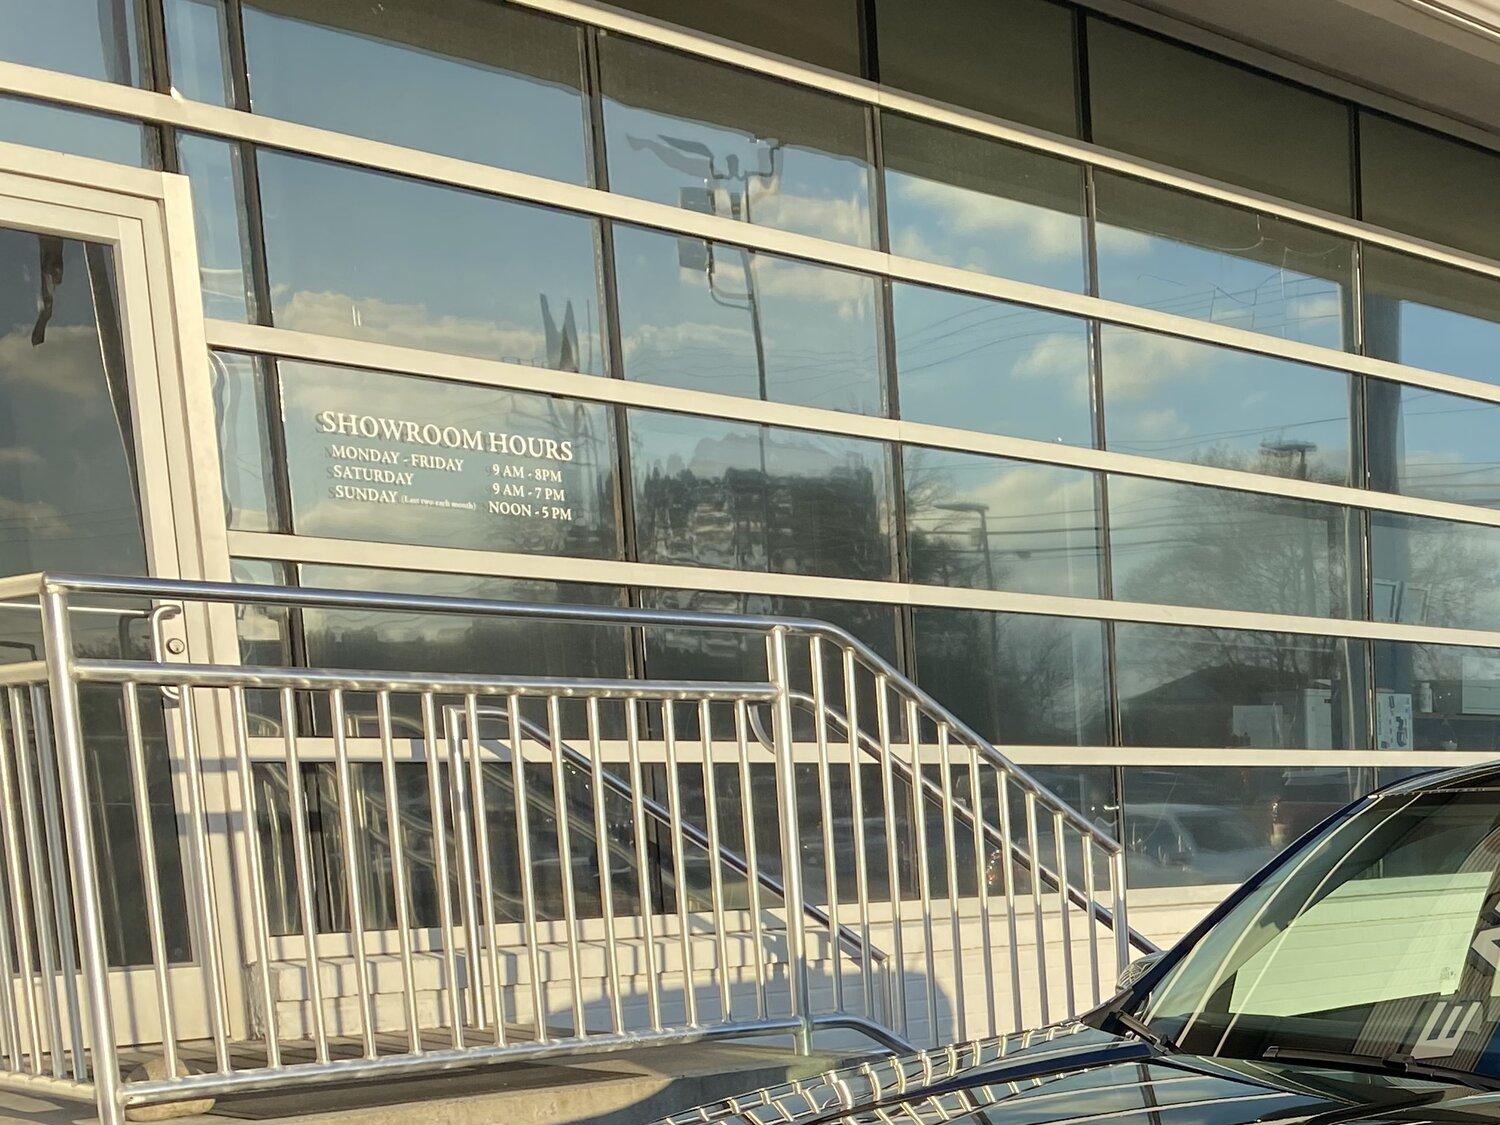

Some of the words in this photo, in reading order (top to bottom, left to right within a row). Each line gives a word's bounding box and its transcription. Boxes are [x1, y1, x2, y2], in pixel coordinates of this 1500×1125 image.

[322, 410, 483, 451] SHOWROOM
[488, 432, 573, 461] HOURS
[331, 444, 400, 465] MONDAY
[411, 453, 464, 472] FRIDAY
[492, 463, 500, 476] 9
[503, 464, 524, 479] AM
[534, 468, 562, 483] 8PM
[333, 464, 414, 486] SATURDAY
[492, 482, 500, 495] 9
[503, 483, 524, 497] AM
[534, 487, 541, 499] 7
[545, 488, 565, 502] PM
[335, 485, 398, 503] SUNDAY
[488, 500, 532, 517] NOON
[542, 506, 549, 519] 5
[551, 506, 572, 521] PM
